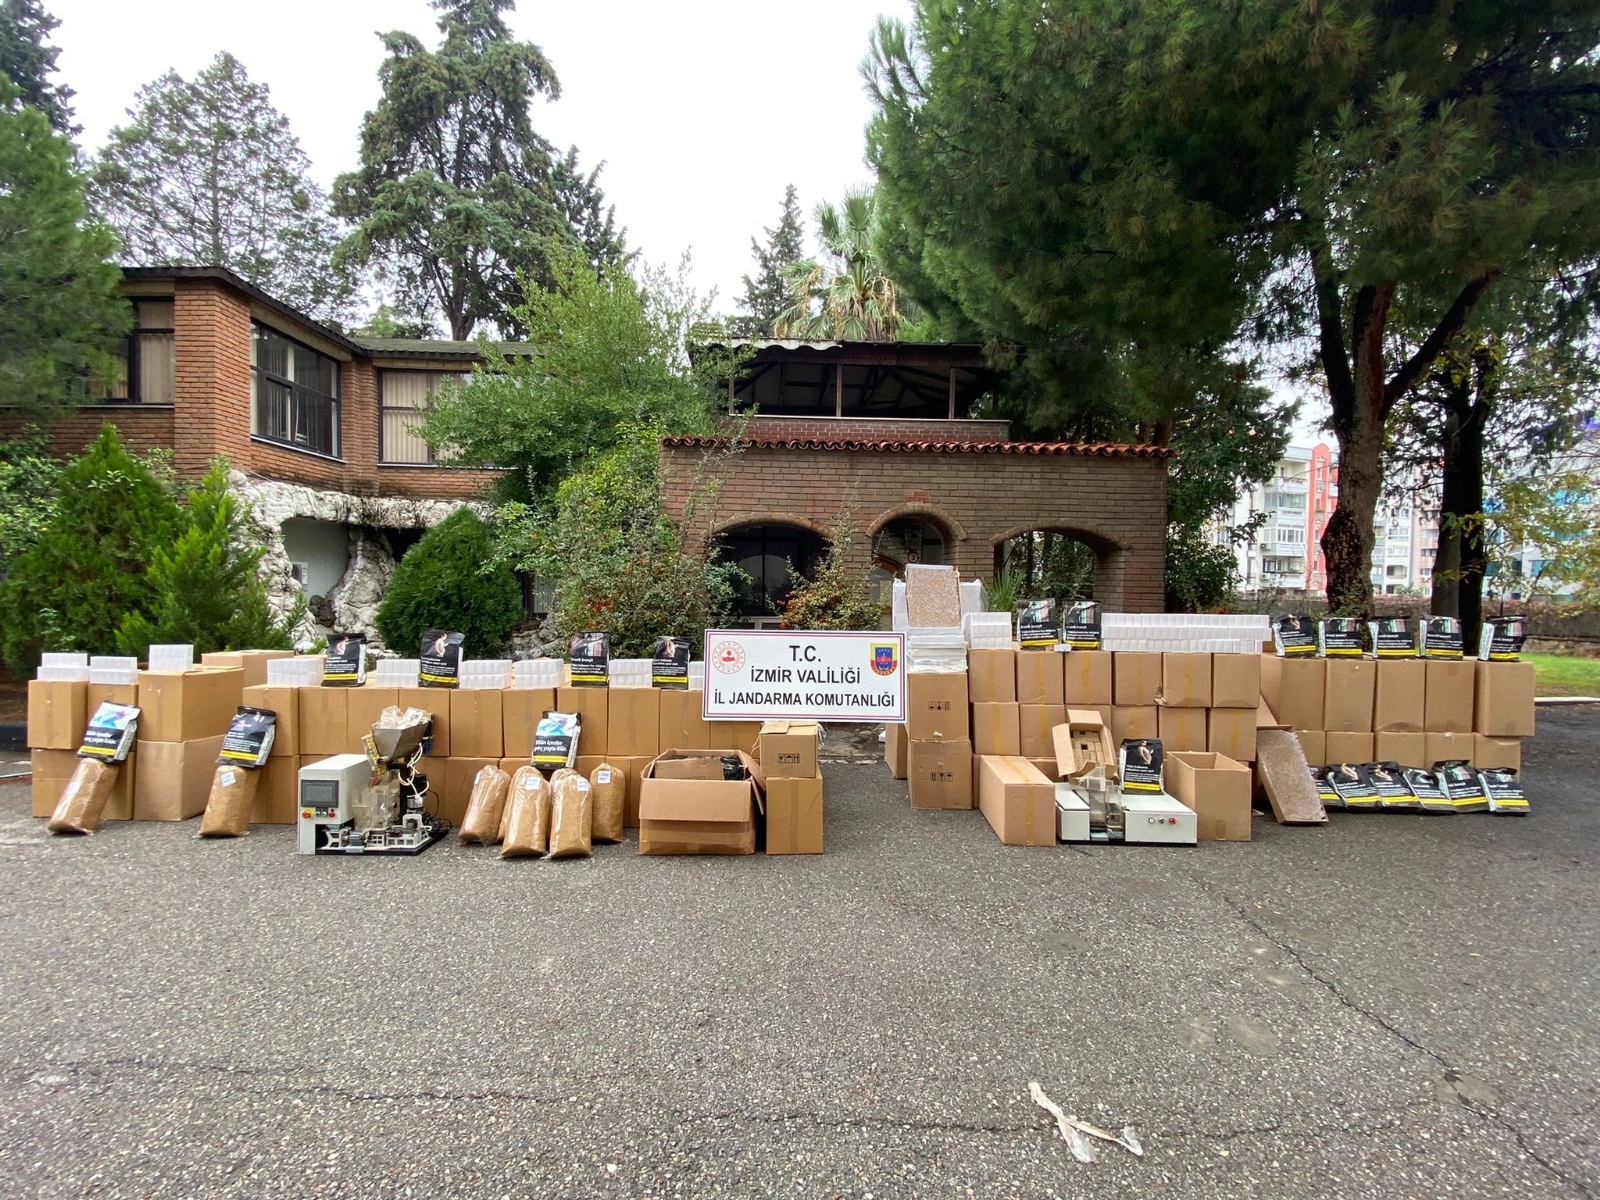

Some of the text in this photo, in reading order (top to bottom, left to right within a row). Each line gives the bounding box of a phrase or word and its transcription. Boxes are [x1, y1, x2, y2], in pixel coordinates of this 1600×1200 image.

[789, 645, 821, 662] T.C.
[751, 665, 860, 684] İZMİR VALİLİĞİ
[714, 689, 895, 707] İL JANDARMA KOMUTANLIĞI
